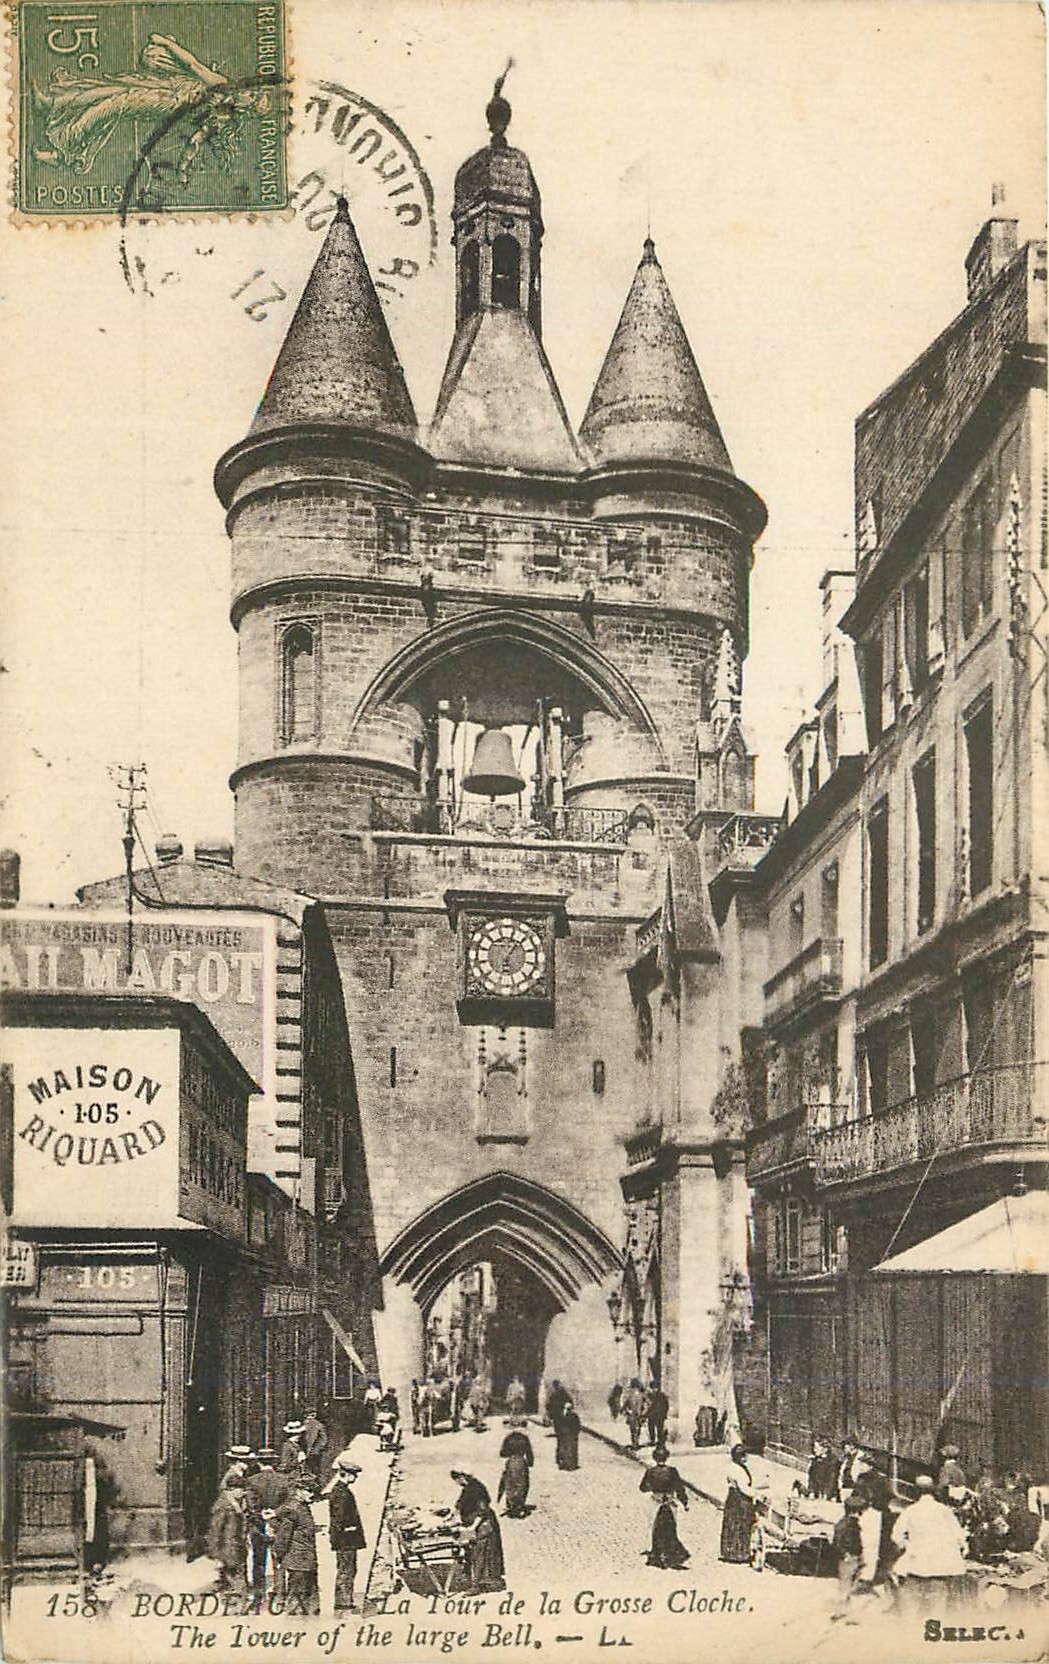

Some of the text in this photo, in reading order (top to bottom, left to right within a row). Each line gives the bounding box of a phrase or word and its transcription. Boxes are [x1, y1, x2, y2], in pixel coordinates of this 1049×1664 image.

[36, 186, 123, 204] POSTES
[80, 948, 264, 1003] MAGOT
[27, 1064, 162, 1105] MAISON
[18, 1113, 166, 1167] RIQUARD
